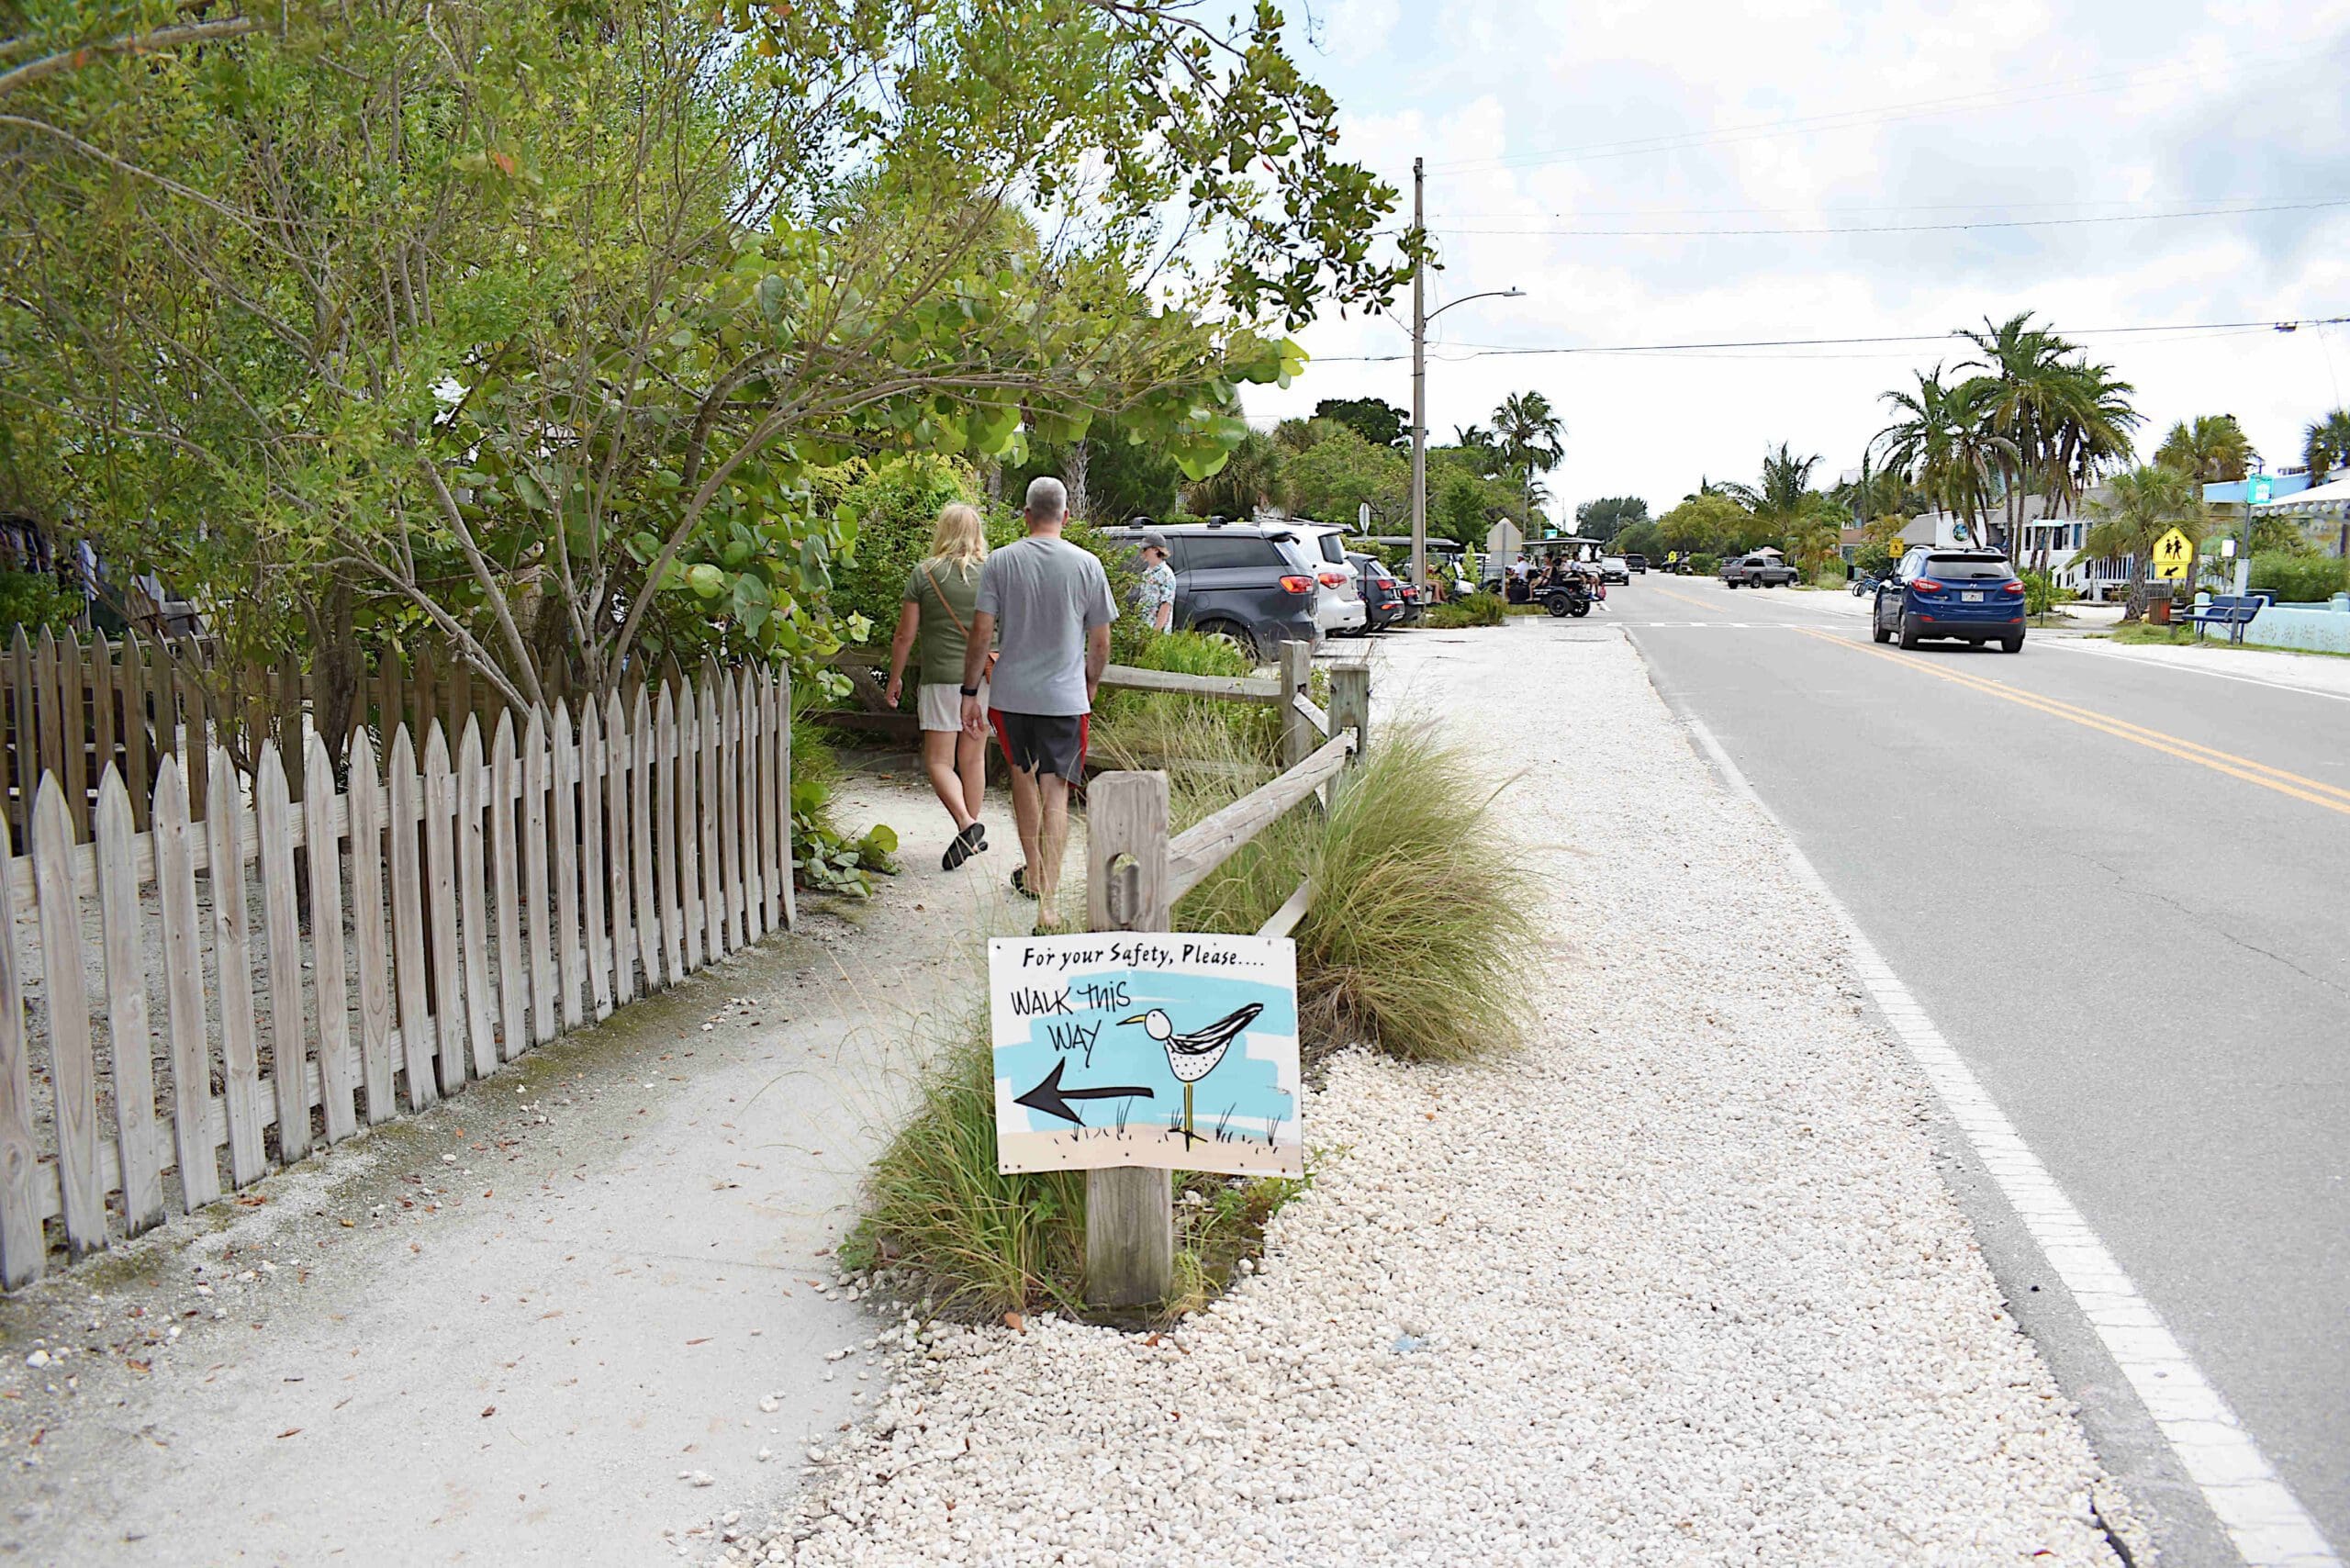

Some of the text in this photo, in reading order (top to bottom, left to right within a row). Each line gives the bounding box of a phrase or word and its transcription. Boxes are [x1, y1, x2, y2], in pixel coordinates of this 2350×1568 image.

[1022, 946, 1056, 968] For
[1058, 949, 1104, 971] your
[1109, 942, 1174, 969] Safety,
[1011, 986, 1074, 1015] WALK
[1046, 1019, 1102, 1070] WAY
